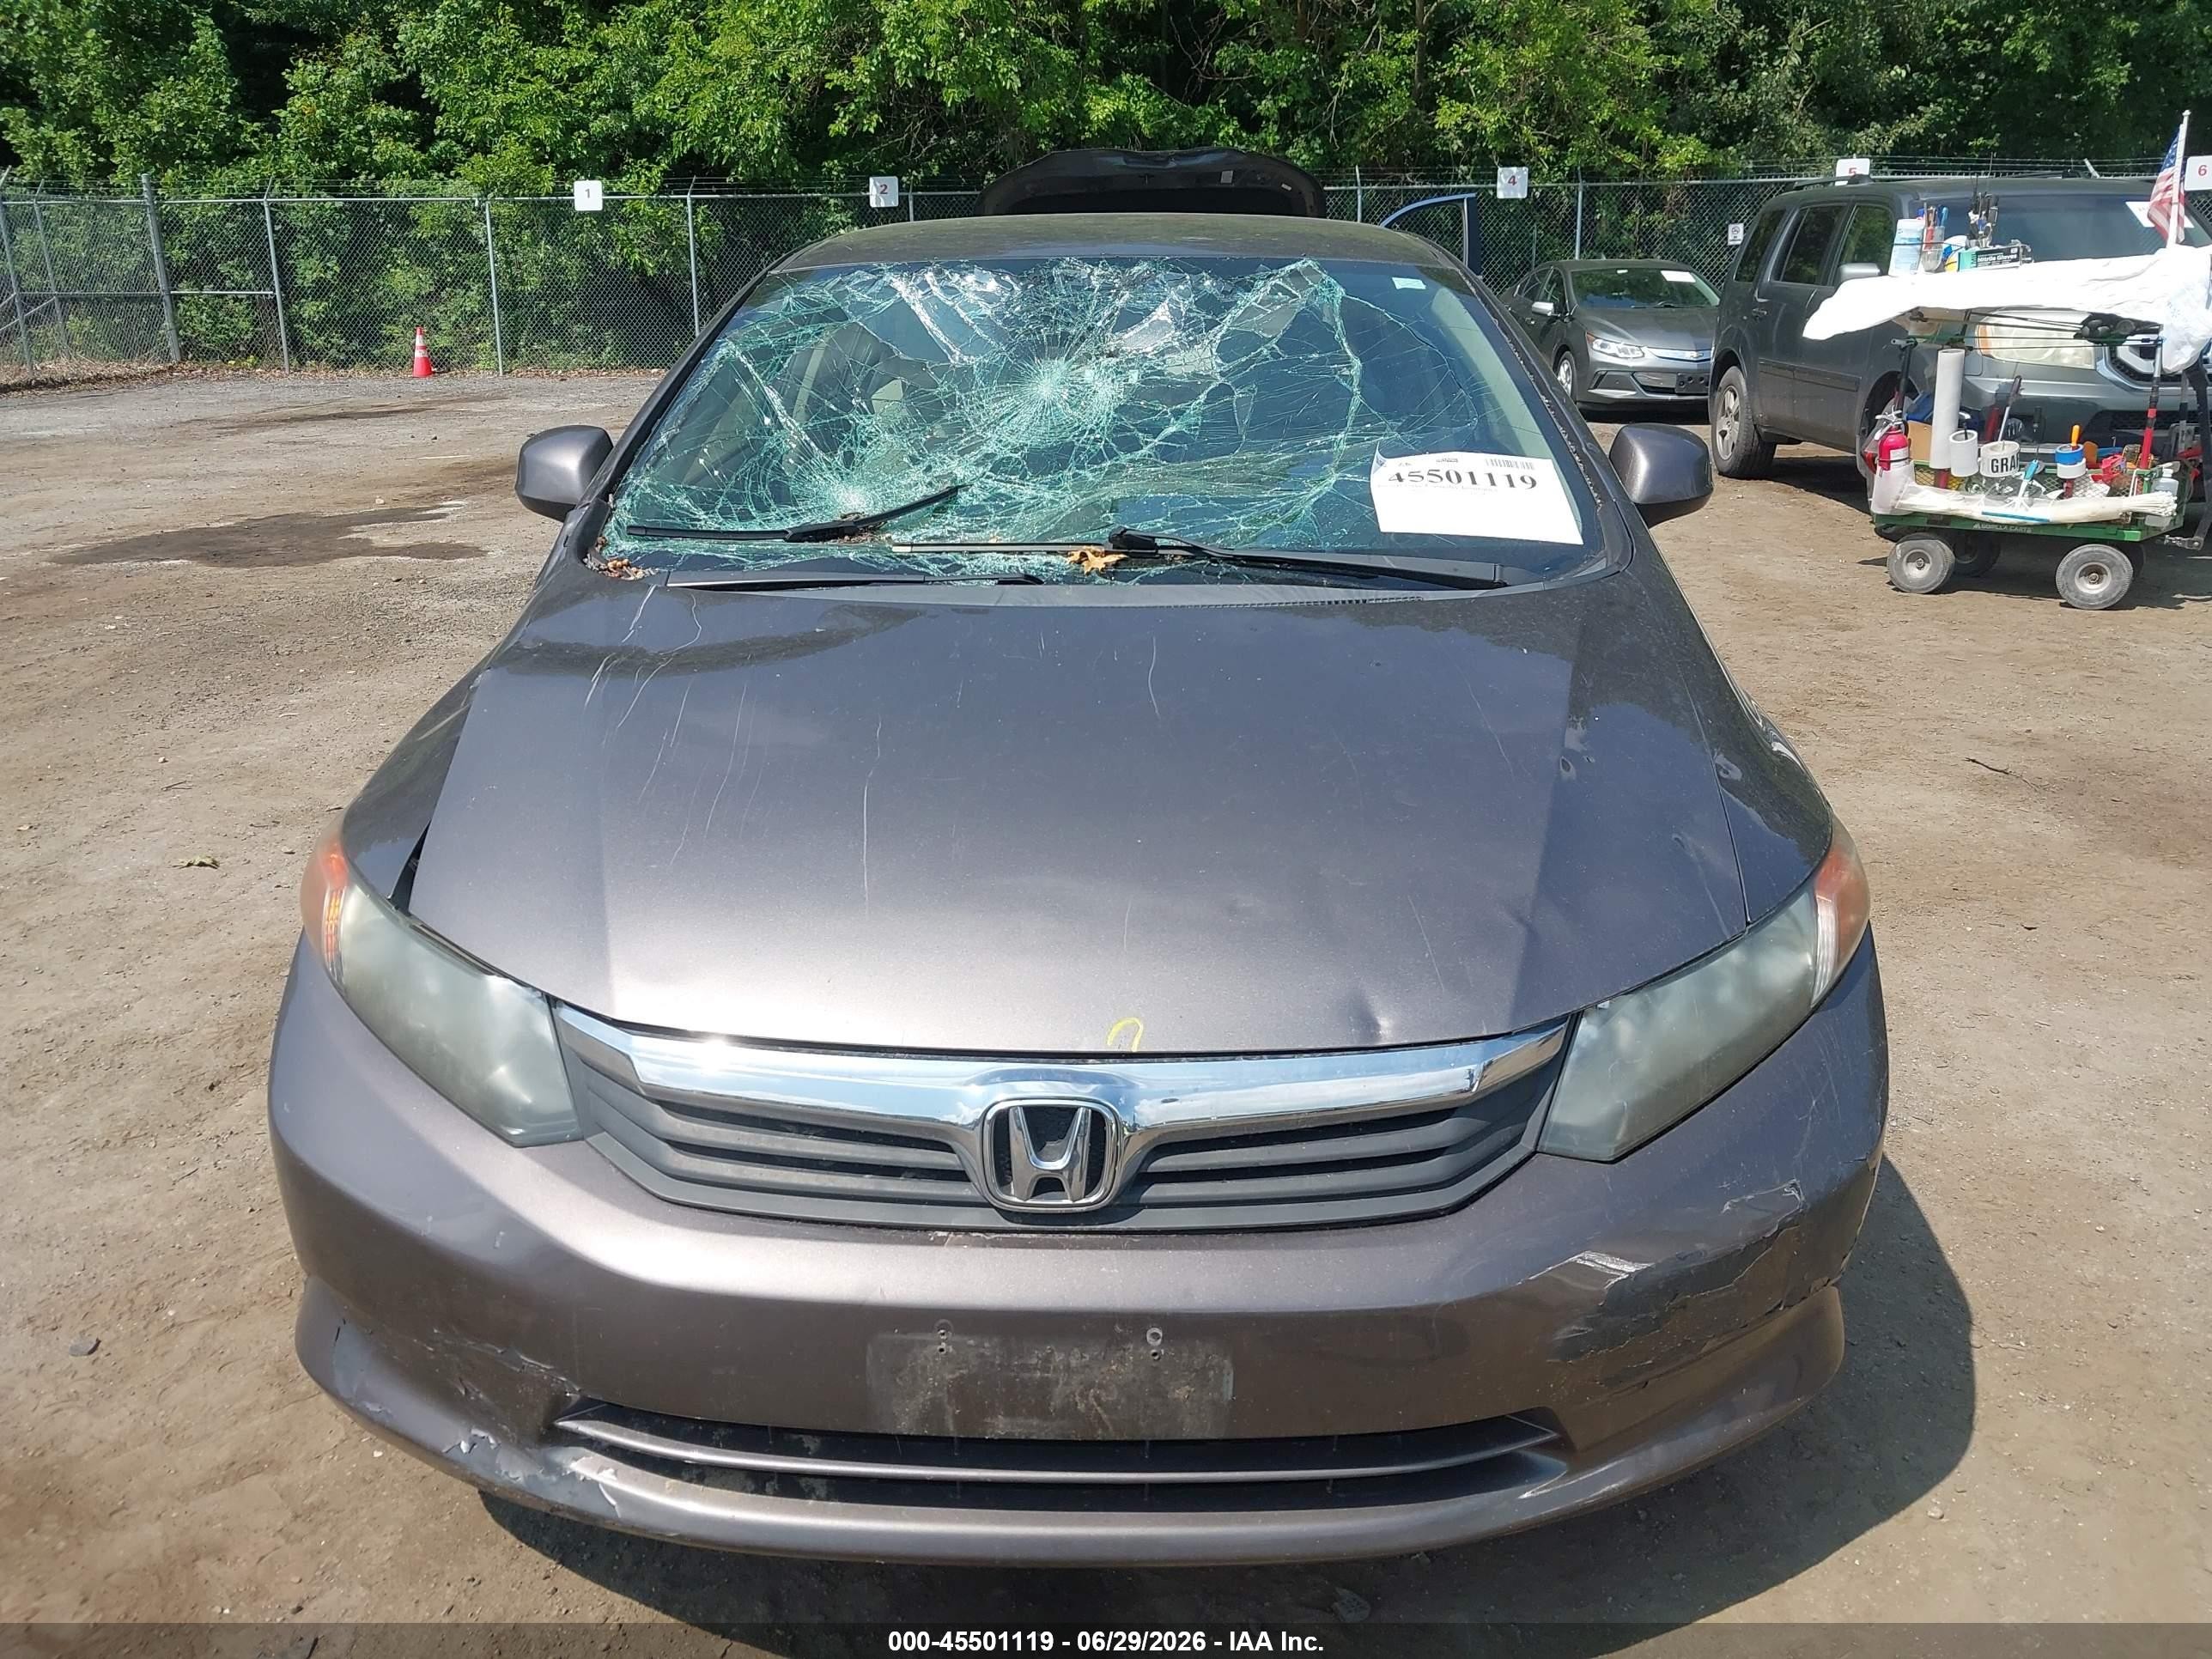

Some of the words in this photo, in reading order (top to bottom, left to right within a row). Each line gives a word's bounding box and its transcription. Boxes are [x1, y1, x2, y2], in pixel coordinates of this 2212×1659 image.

[1848, 167, 1856, 178] 5
[2197, 164, 2208, 176] 6
[1507, 175, 1517, 186] 4
[585, 188, 591, 198] 1
[879, 184, 889, 195] 2
[1388, 468, 1537, 490] 45501119
